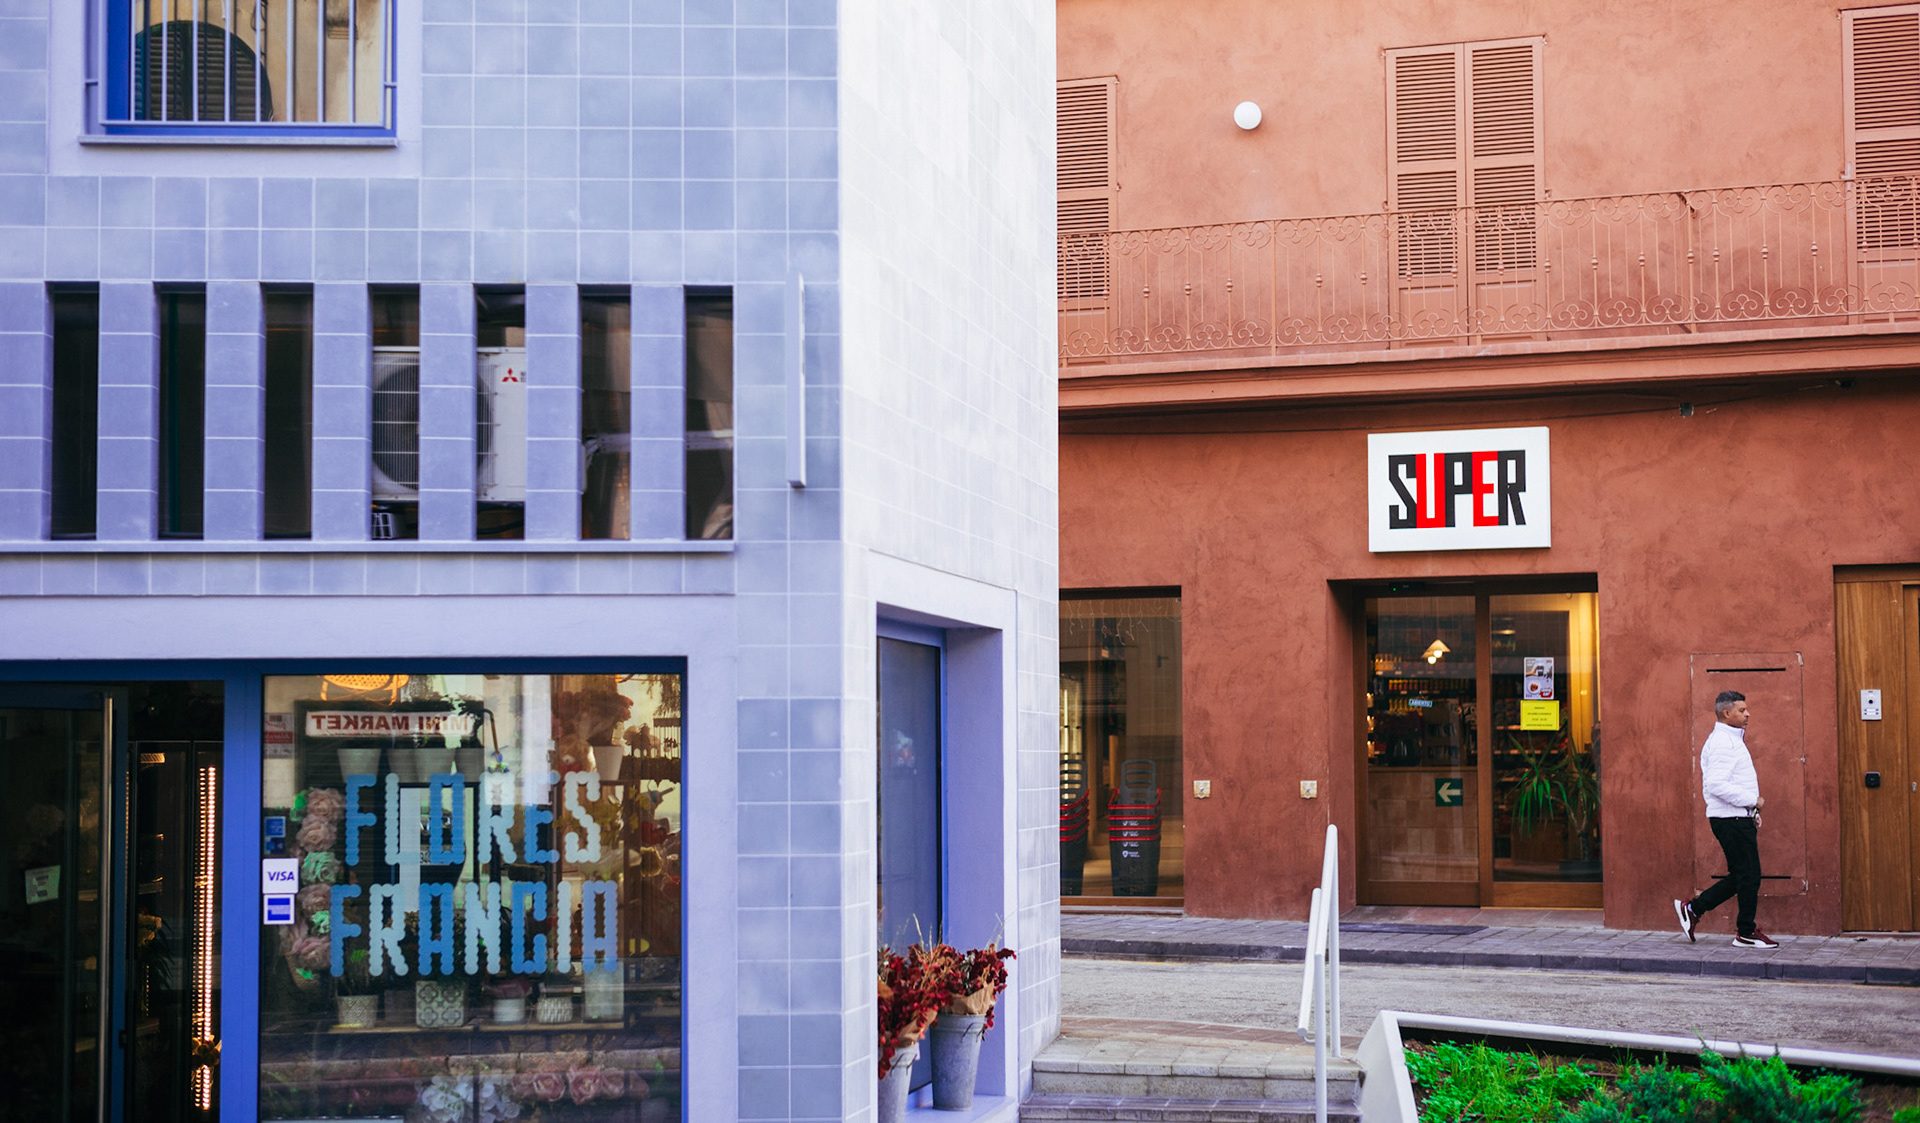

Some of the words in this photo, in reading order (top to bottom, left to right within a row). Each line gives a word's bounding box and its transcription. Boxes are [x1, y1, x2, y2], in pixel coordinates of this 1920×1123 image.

[1388, 449, 1526, 529] SUPER
[345, 771, 601, 866] FLORES
[267, 870, 295, 881] VISA
[330, 880, 618, 977] FRANCIA
